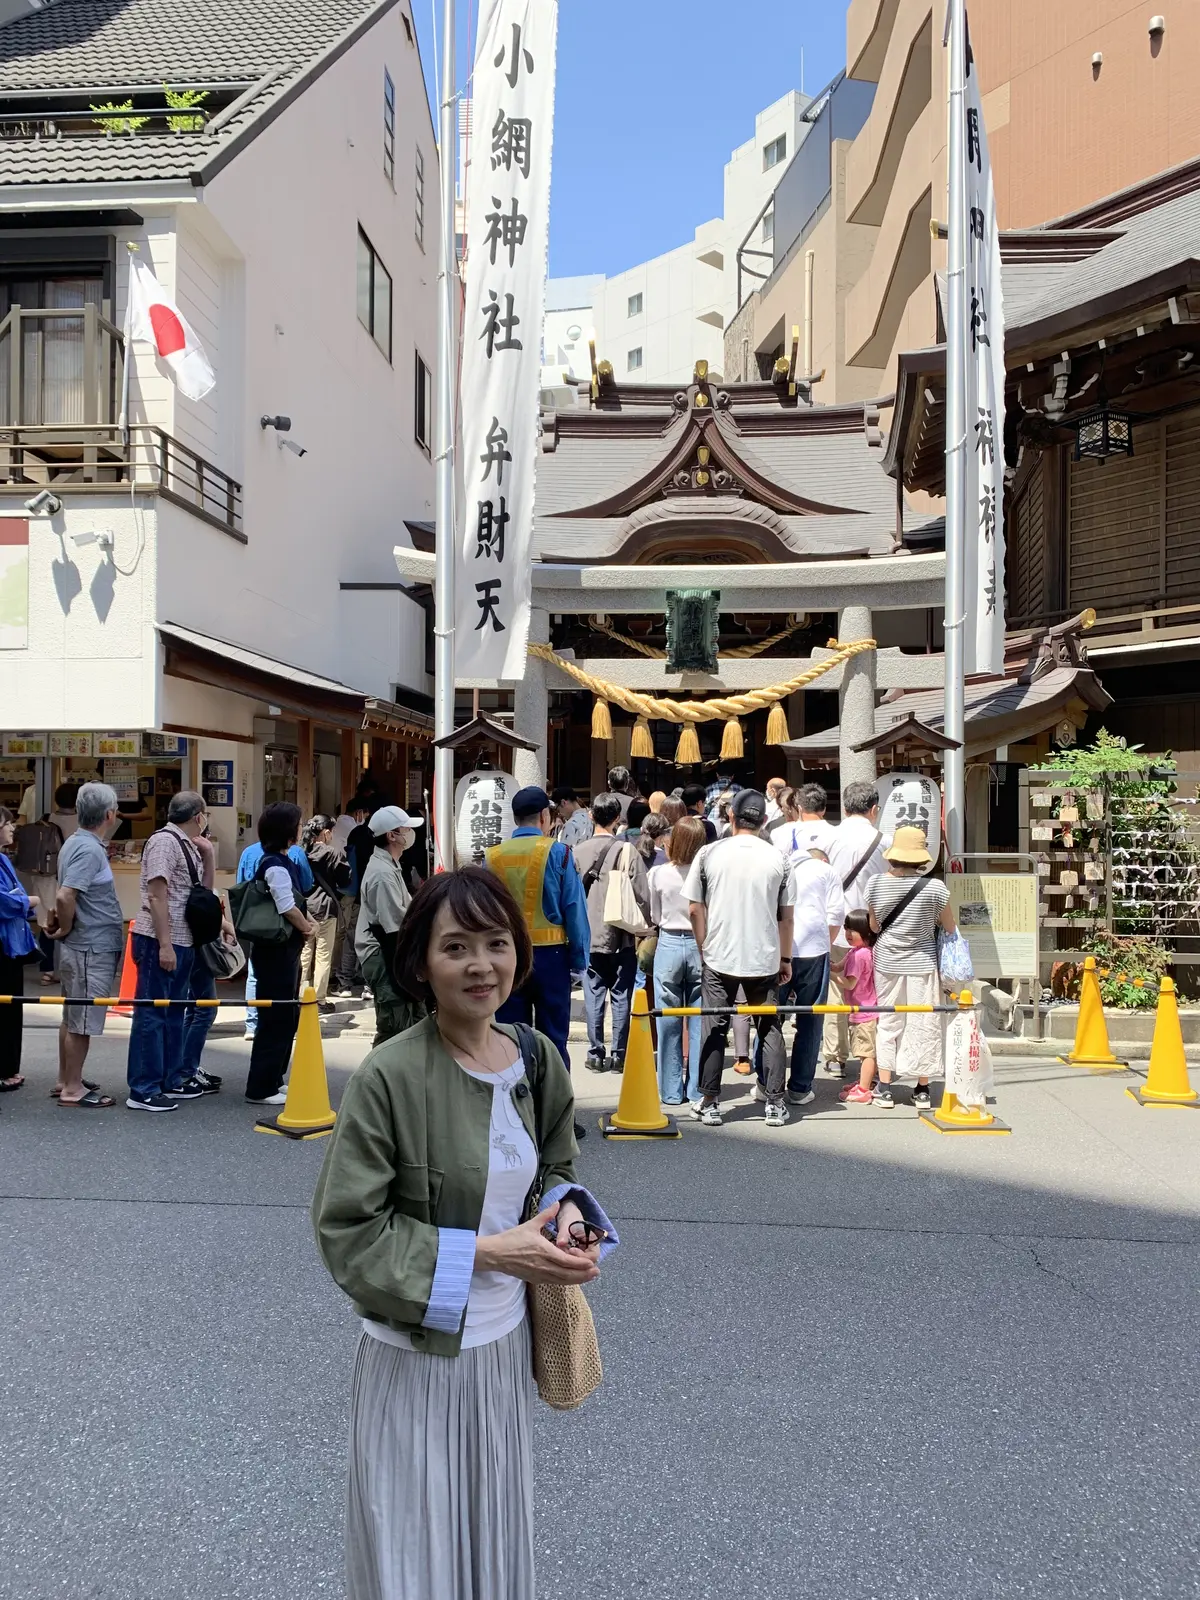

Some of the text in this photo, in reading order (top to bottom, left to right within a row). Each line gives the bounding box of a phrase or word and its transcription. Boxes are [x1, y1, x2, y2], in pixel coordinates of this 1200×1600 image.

[474, 23, 534, 634] 小網神社 弁財天
